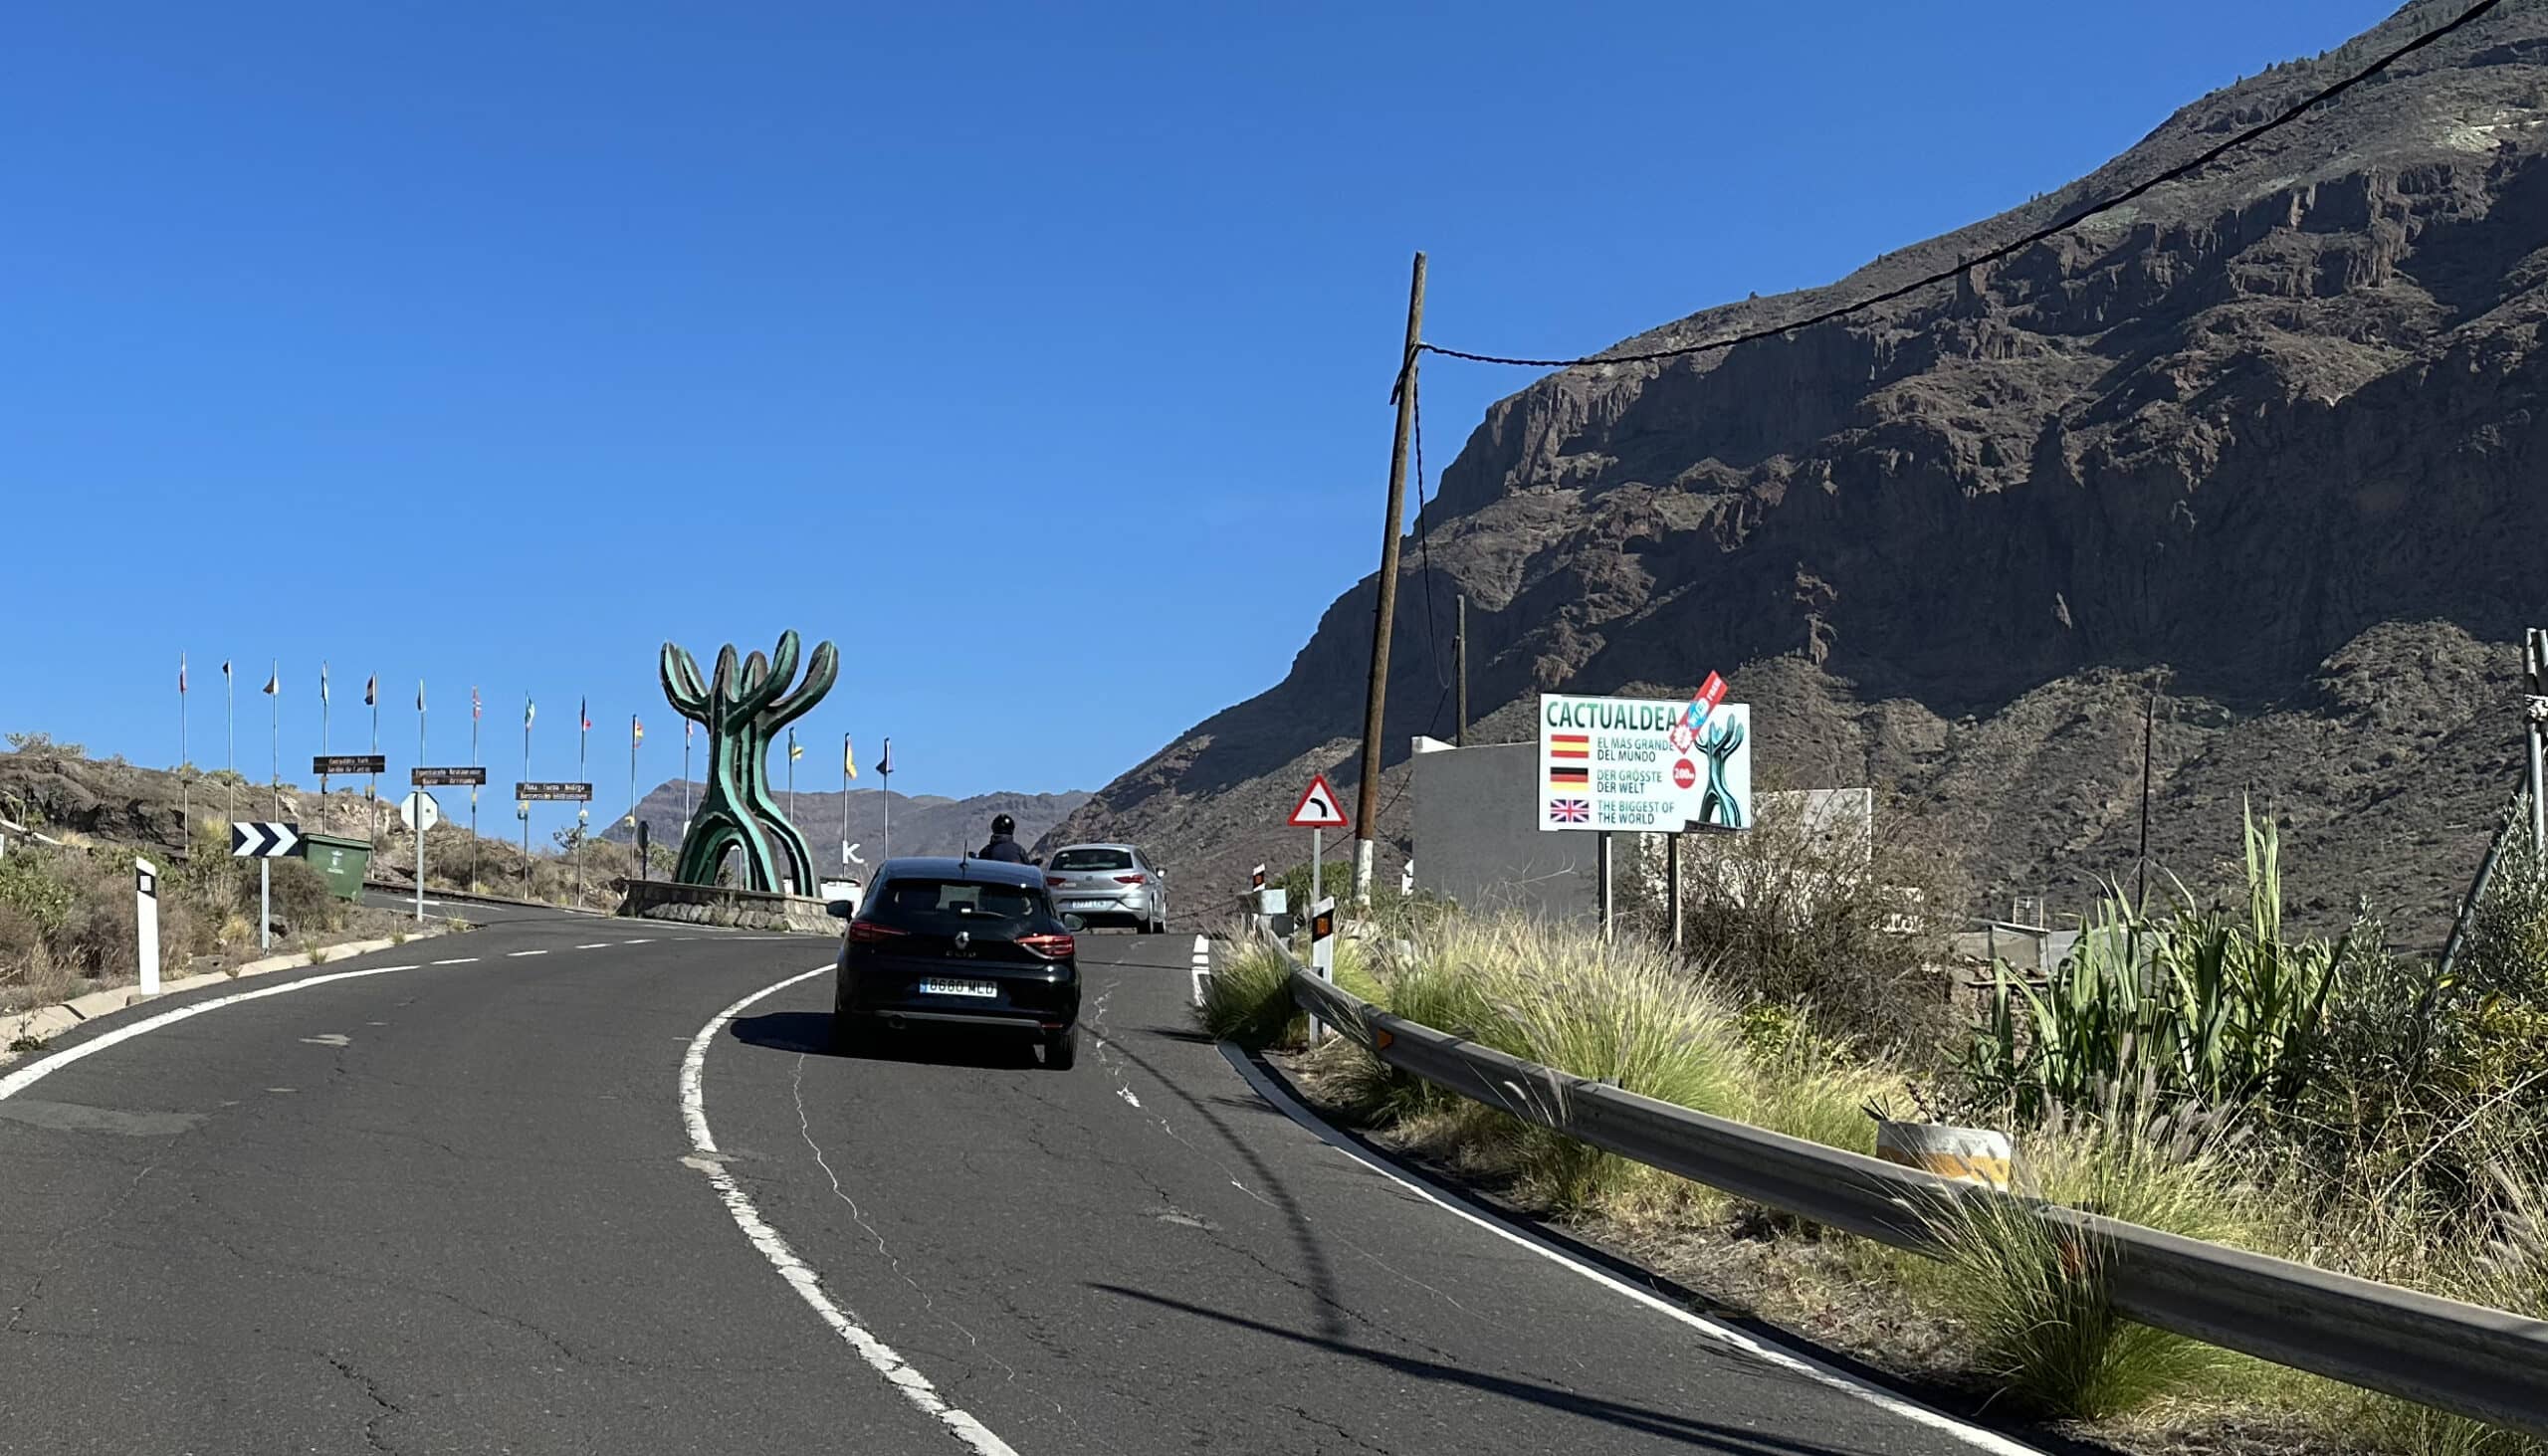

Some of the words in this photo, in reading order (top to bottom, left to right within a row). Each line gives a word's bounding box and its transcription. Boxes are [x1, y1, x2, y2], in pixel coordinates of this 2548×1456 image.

[1547, 702, 1677, 730] CACTUALDEA
[1597, 737, 1608, 748] EL
[1634, 738, 1674, 751] GRANDE
[1597, 749, 1615, 761] DEL
[1618, 750, 1655, 762] MUNDO
[1597, 769, 1615, 781] DER
[1597, 781, 1616, 793] DER
[1619, 782, 1644, 794] WELT
[1597, 799, 1615, 811] THE
[1619, 800, 1658, 813] BIGGEST
[1662, 802, 1674, 813] OF
[1597, 812, 1615, 824] THE
[1619, 813, 1654, 825] WORLD
[843, 841, 864, 864] K
